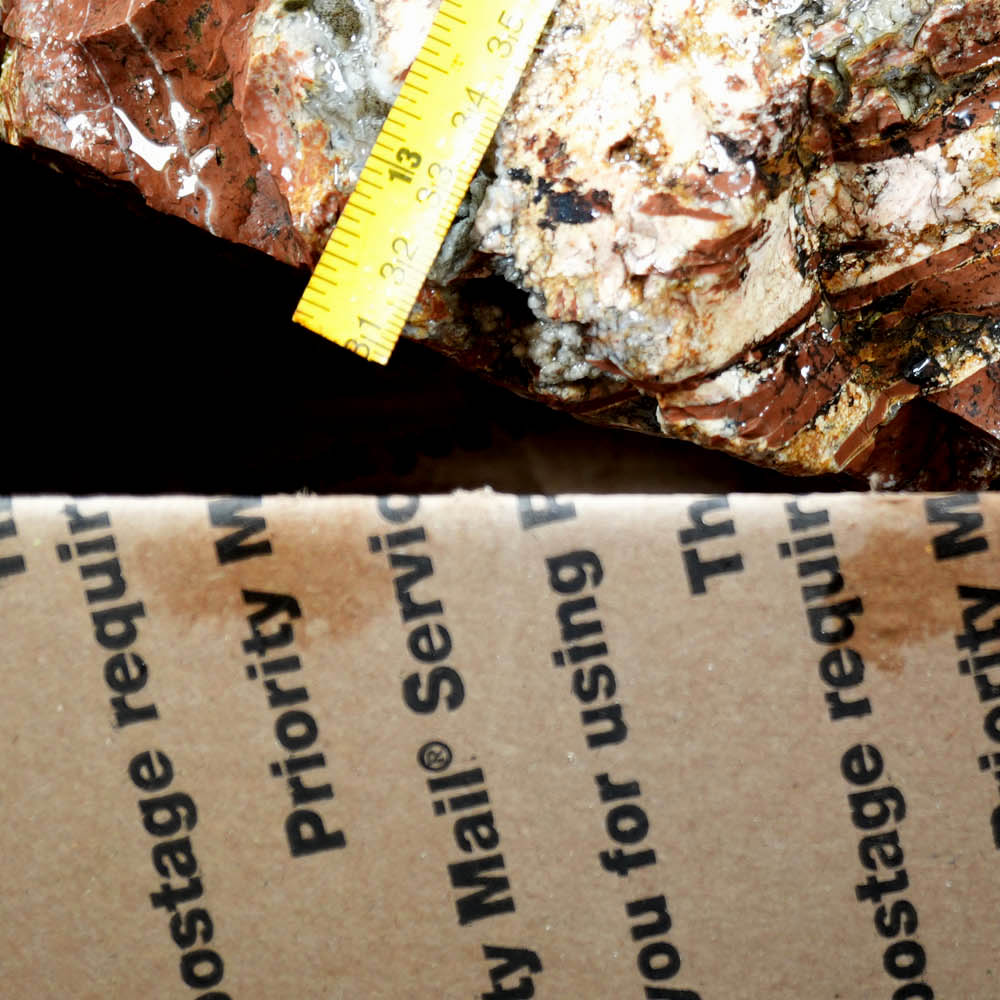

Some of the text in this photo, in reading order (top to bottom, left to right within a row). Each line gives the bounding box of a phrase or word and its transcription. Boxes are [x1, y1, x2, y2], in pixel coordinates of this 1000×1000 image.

[486, 8, 525, 60] 35
[450, 85, 490, 131] 34
[386, 145, 423, 186] 13
[378, 236, 418, 287] 32
[546, 551, 621, 748] using
[241, 588, 346, 857] Priority
[129, 751, 232, 1000] ostage
[418, 741, 515, 926] Mail®
[596, 773, 656, 876] for
